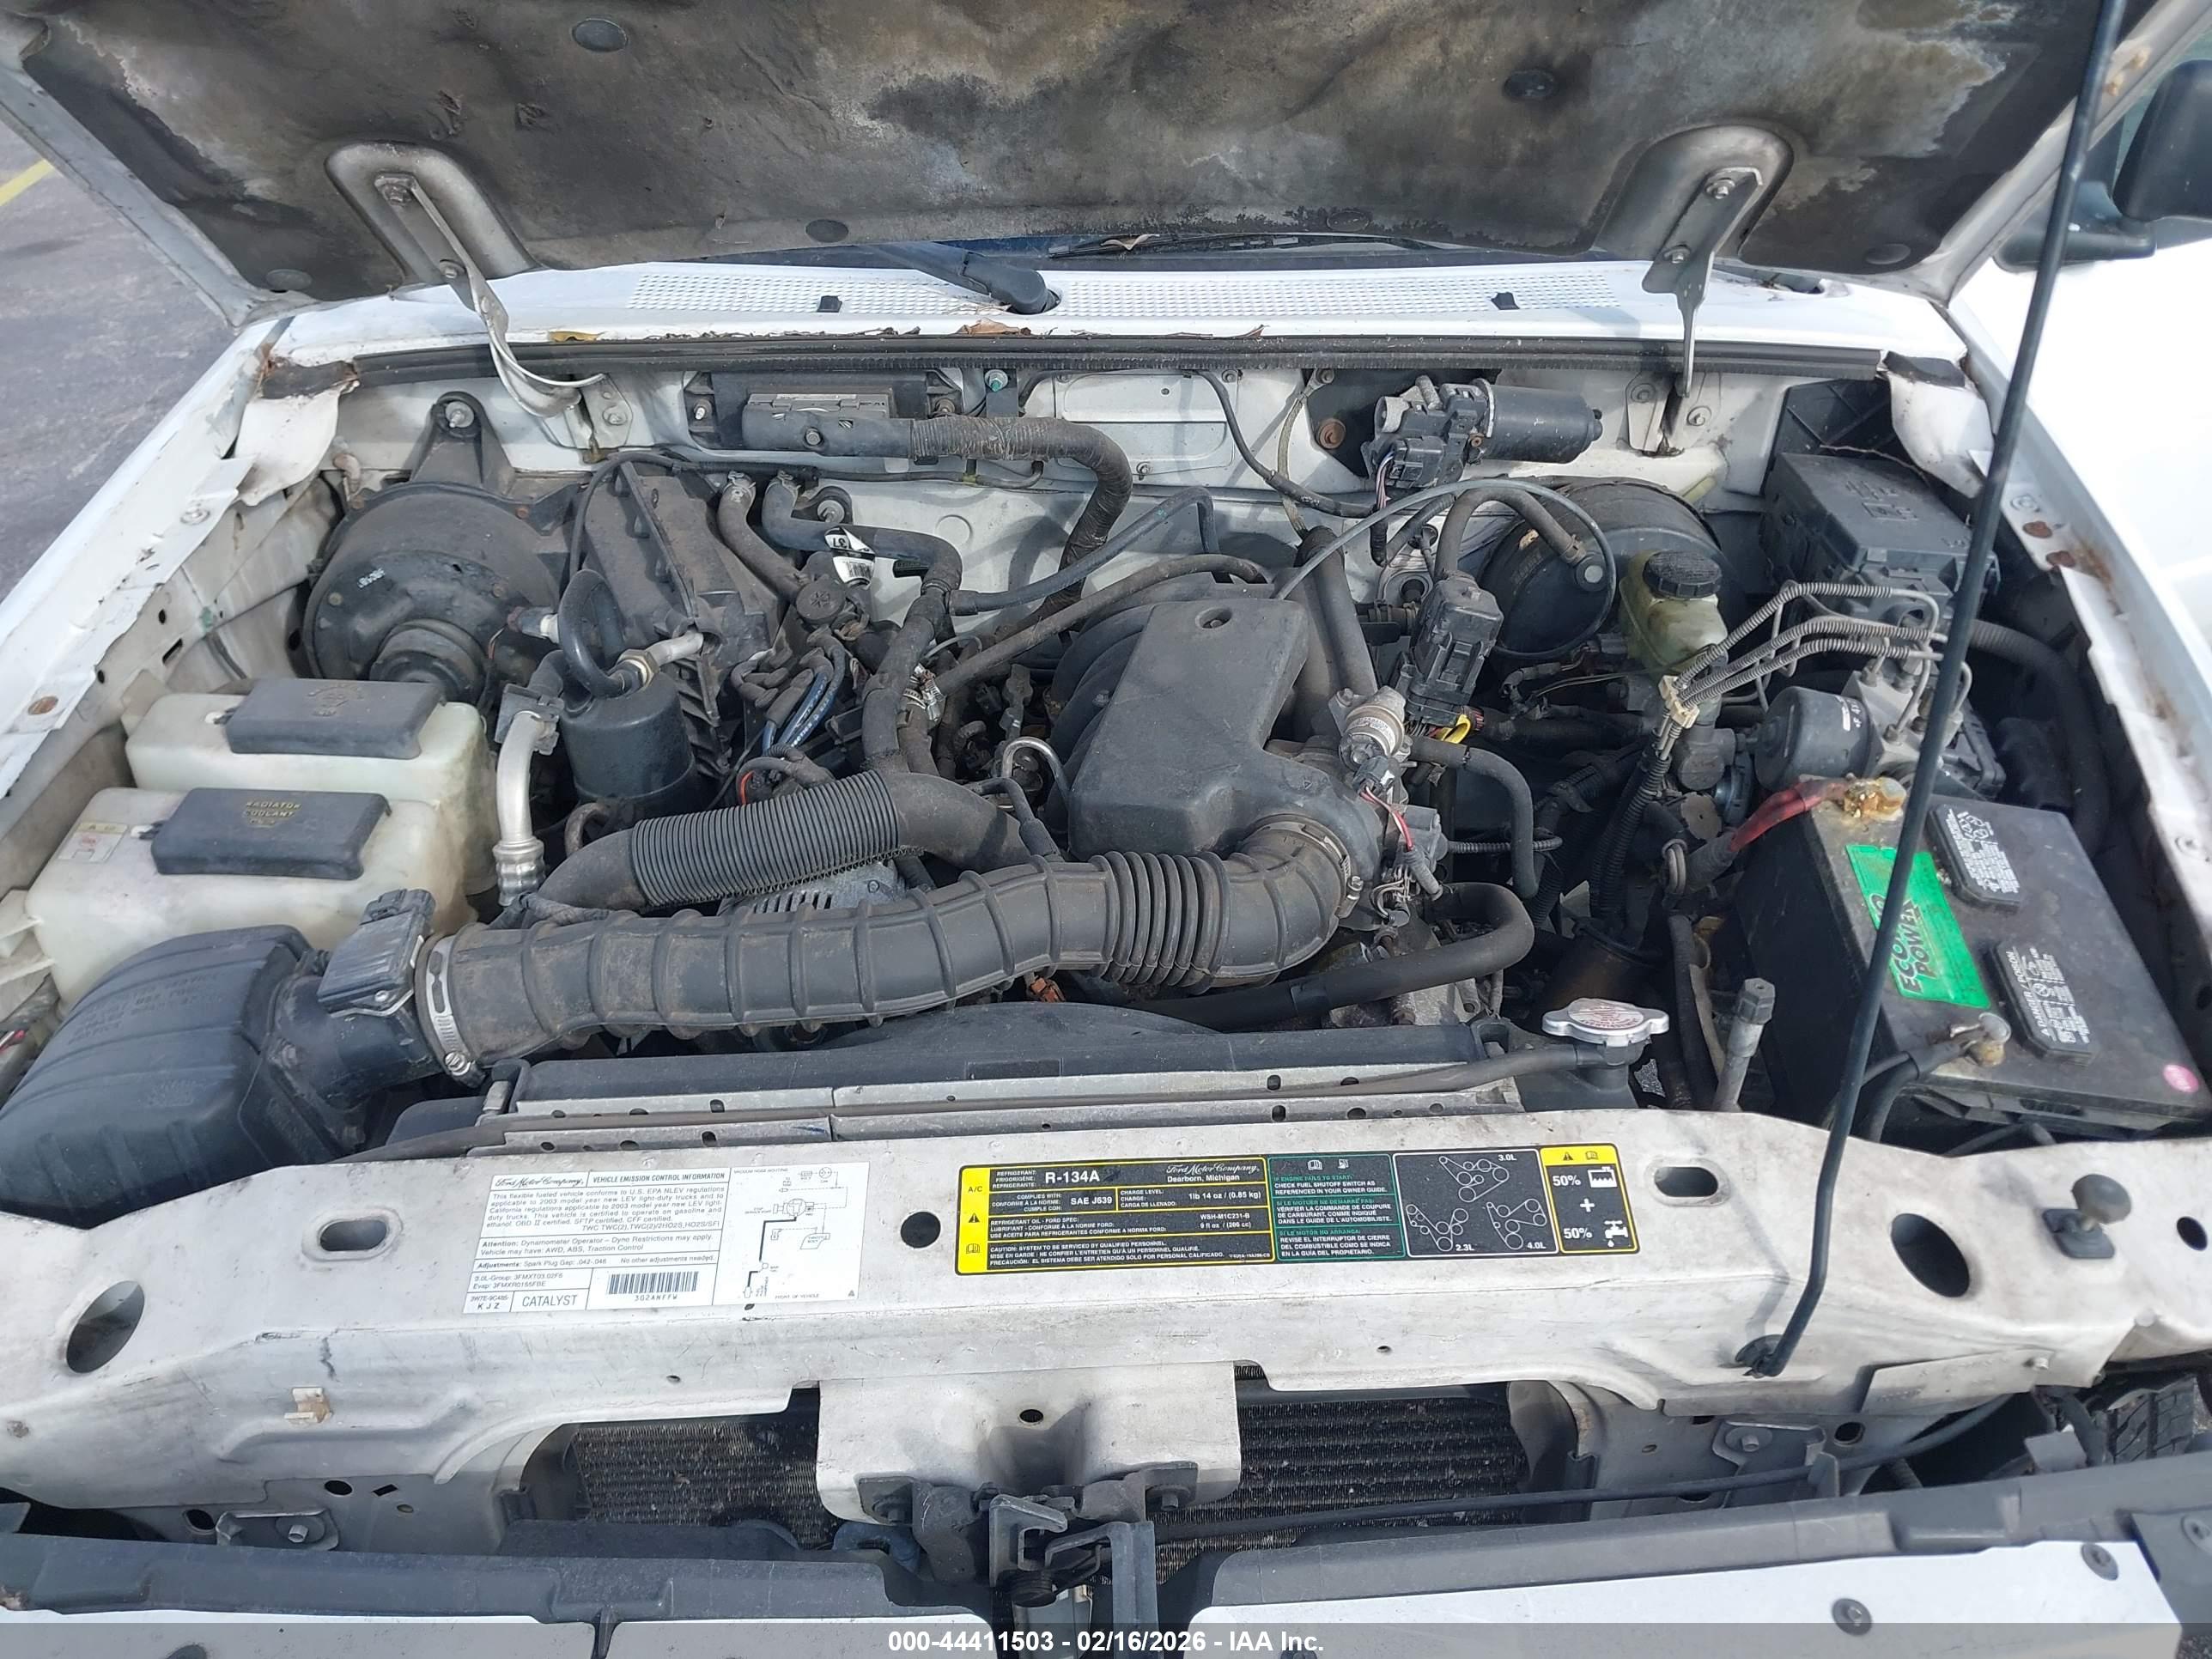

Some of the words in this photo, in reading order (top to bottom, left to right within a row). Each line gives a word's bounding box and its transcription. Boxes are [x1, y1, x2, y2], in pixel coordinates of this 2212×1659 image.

[1166, 1164, 1188, 1174] Ford
[1185, 1164, 1215, 1176] Motor
[1045, 1170, 1100, 1184] R-134A
[1552, 1175, 1582, 1187] 50%
[1070, 1197, 1089, 1206] SAE
[1249, 1191, 1261, 1200] kg)
[1563, 1227, 1593, 1240] 50%
[1455, 1243, 1475, 1252] 2.3L
[1527, 1242, 1547, 1250] 4.0L
[522, 1295, 578, 1307] CATALYST
